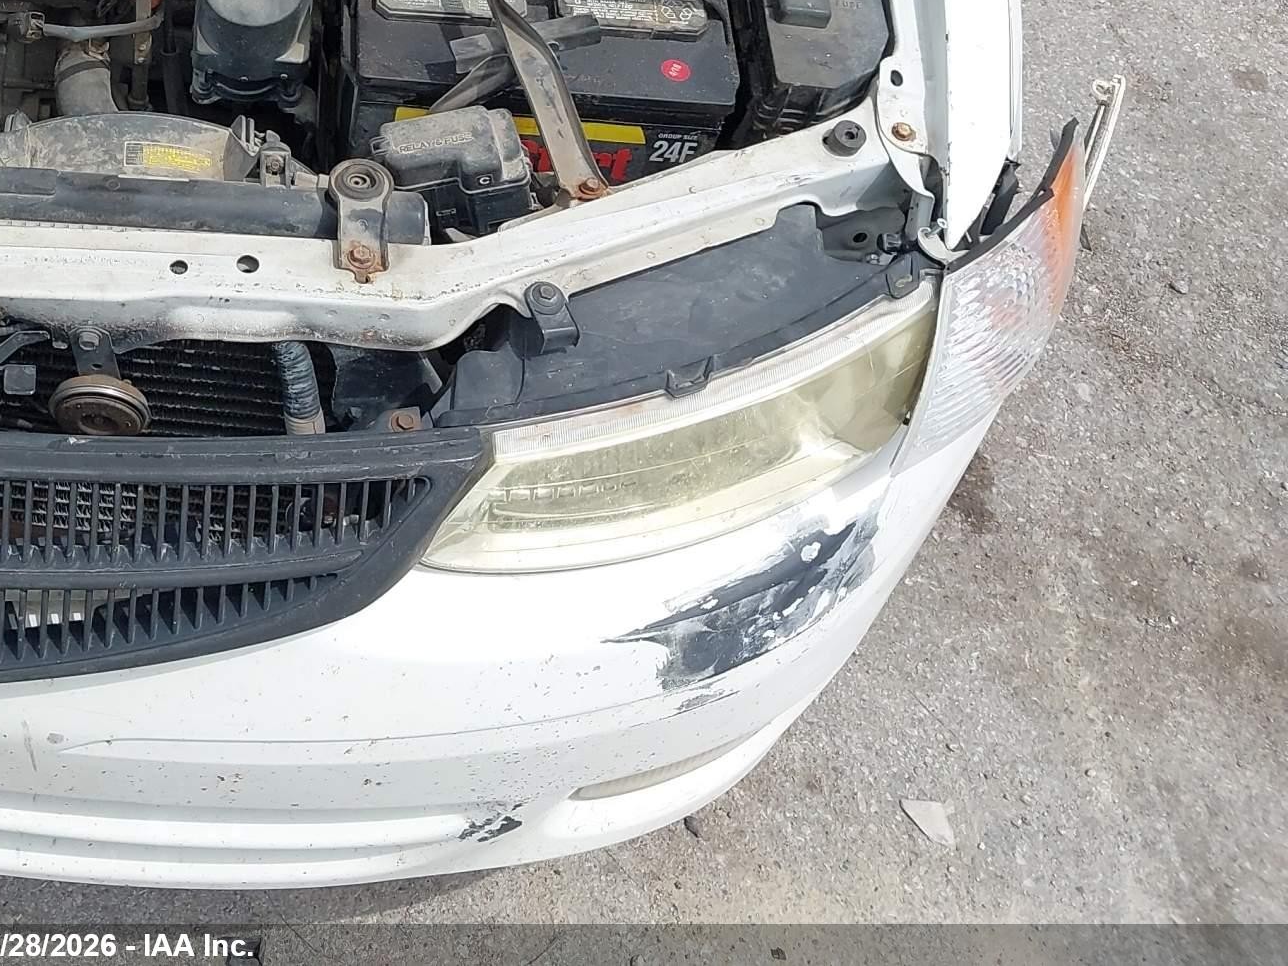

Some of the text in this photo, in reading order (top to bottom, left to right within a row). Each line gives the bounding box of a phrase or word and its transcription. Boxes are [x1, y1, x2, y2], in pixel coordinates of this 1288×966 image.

[399, 140, 432, 154] RELAY
[444, 131, 474, 146] FUSE
[649, 140, 698, 163] 24F
